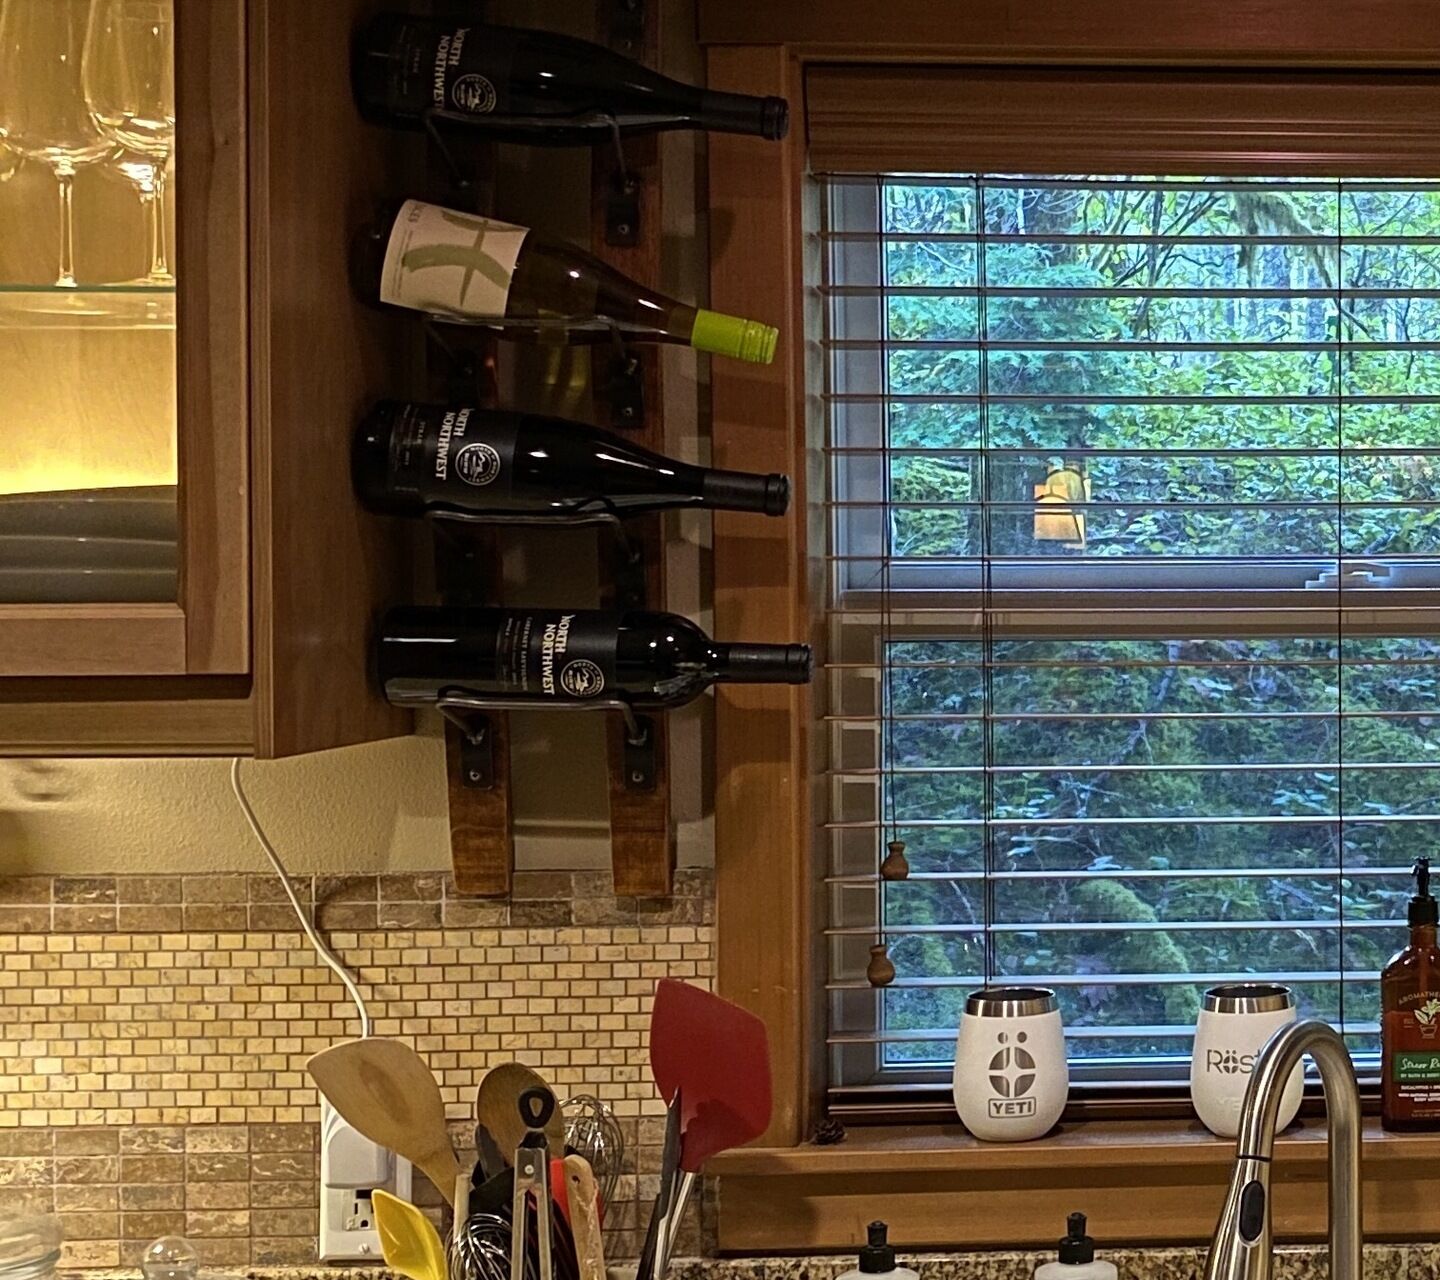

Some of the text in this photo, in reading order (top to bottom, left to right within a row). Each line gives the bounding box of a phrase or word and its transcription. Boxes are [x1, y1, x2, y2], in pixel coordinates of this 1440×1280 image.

[433, 35, 451, 110] NORTHWEST
[435, 411, 457, 481] NORTHWEST
[542, 623, 557, 696] NORTHWEST
[554, 613, 577, 654] NORTH
[992, 1102, 1033, 1115] YETI
